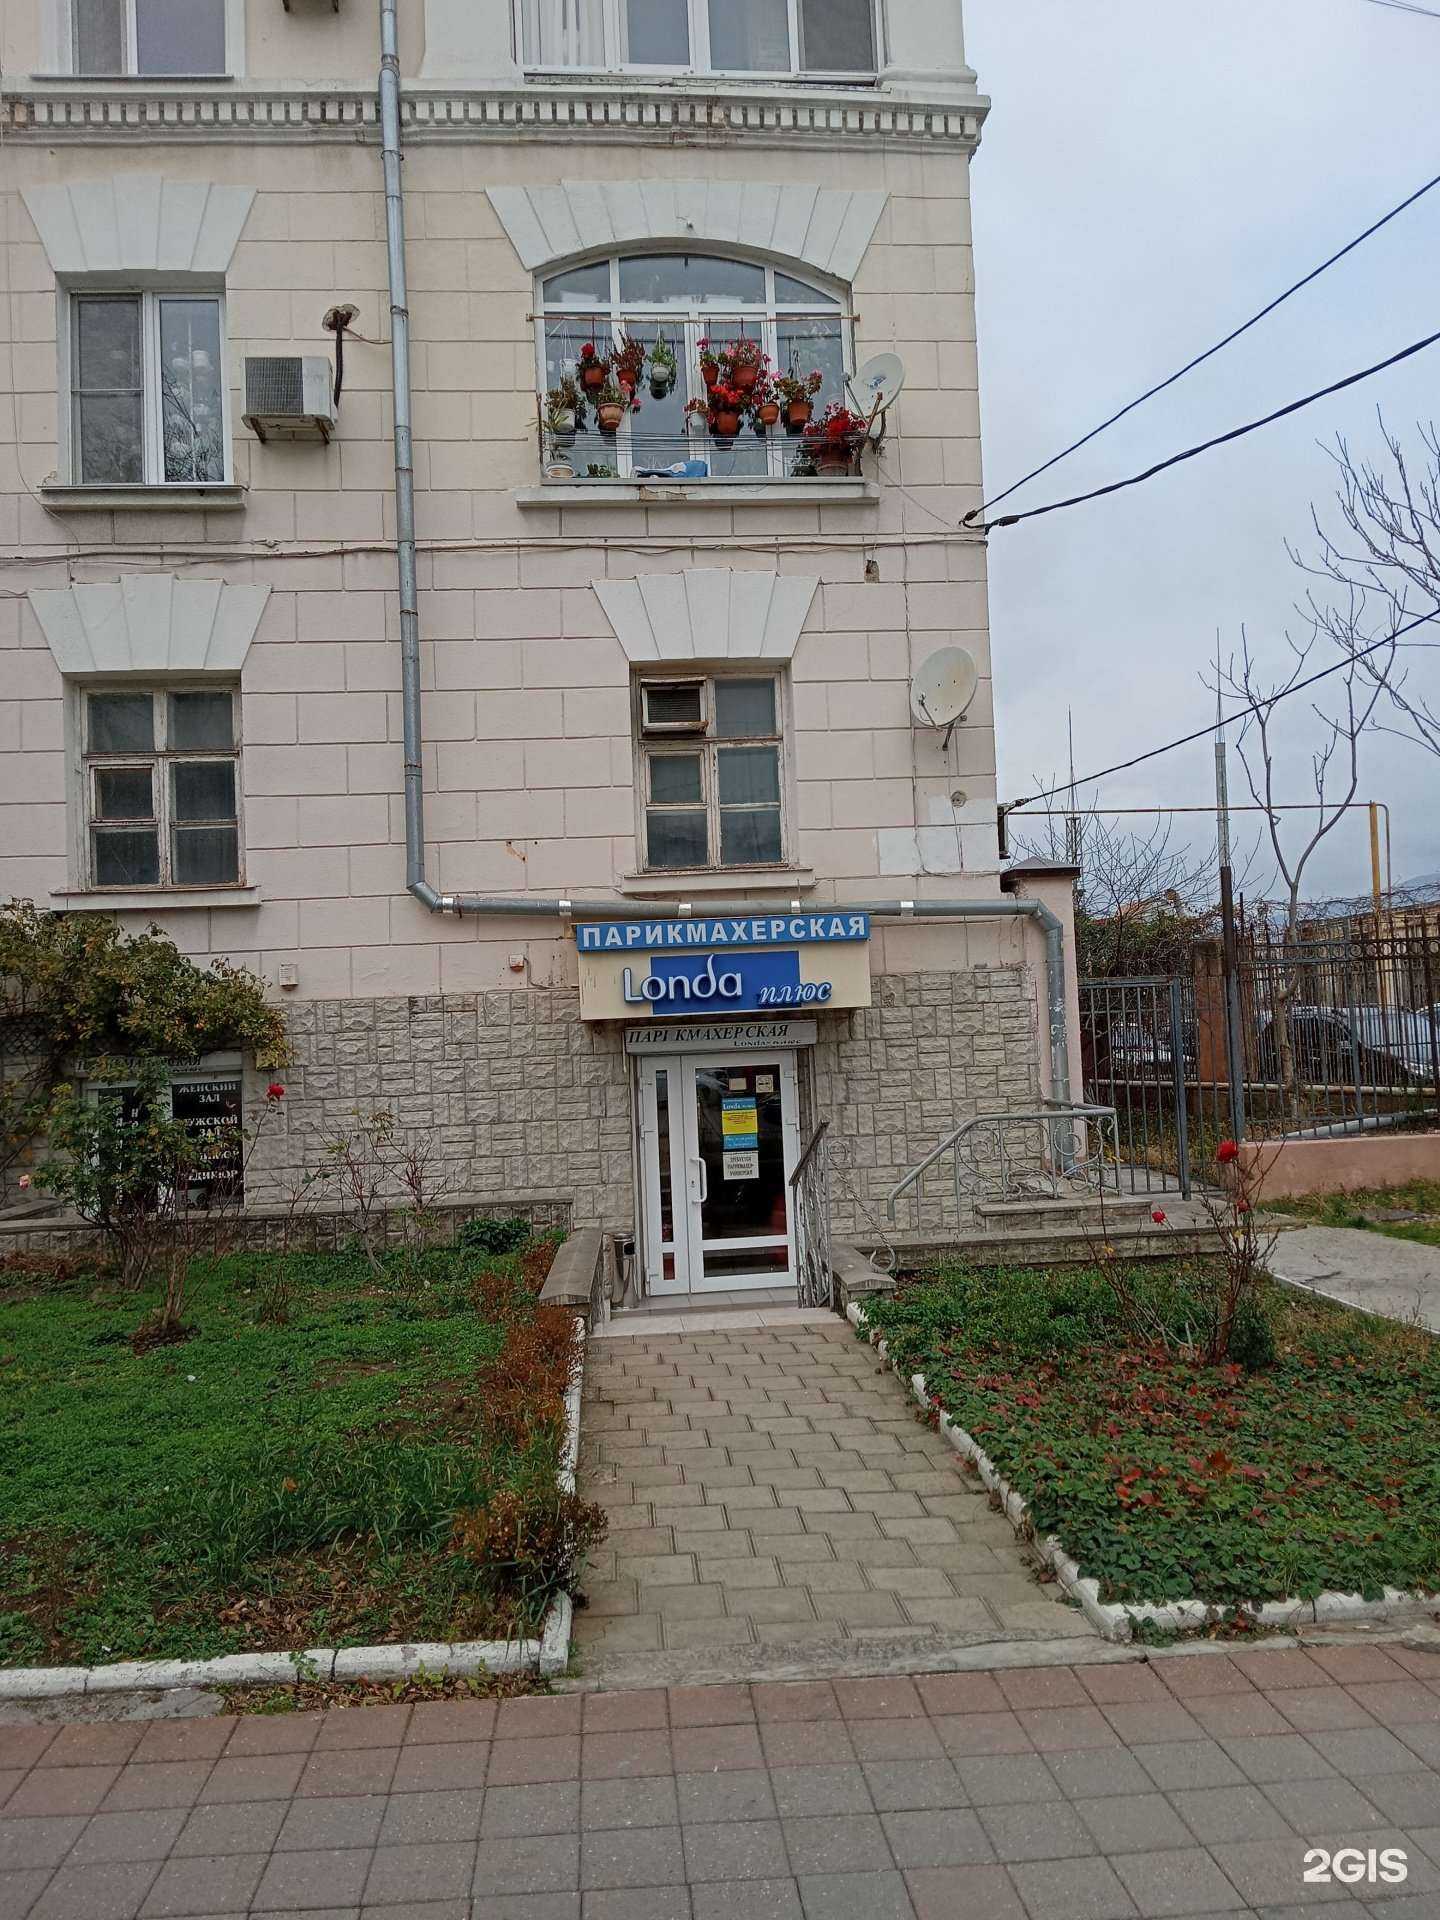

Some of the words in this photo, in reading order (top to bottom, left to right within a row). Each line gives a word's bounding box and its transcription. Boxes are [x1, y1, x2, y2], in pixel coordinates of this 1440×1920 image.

[582, 916, 866, 948] ПАРИКМАХЕРСКАЯ
[623, 953, 743, 1002] Londa
[757, 982, 833, 1006] плюс
[199, 1093, 220, 1103] ЗАЛ
